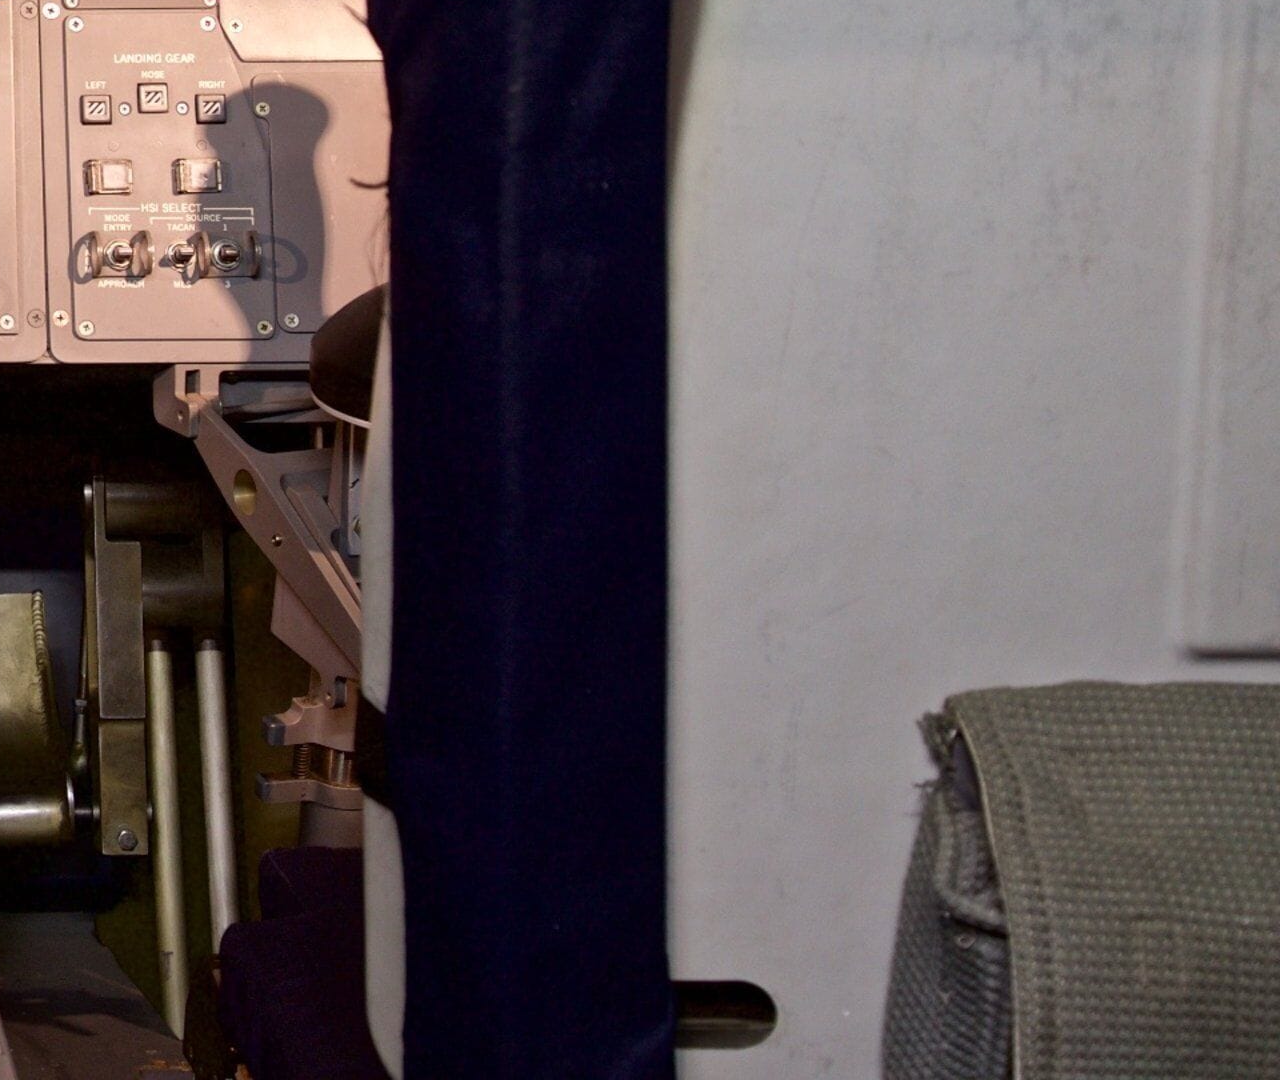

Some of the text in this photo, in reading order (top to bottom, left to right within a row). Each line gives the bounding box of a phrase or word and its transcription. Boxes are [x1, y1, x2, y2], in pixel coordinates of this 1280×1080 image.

[113, 54, 196, 63] LANDING GEAR
[140, 70, 165, 78] NOSE
[85, 80, 106, 89] LEFT
[198, 80, 226, 89] RIGHT
[140, 203, 203, 212] HSI SELECT
[104, 214, 130, 222] MODE
[185, 214, 221, 222] SOURCE
[103, 223, 132, 231] ENTRY
[167, 223, 195, 231] TACAN
